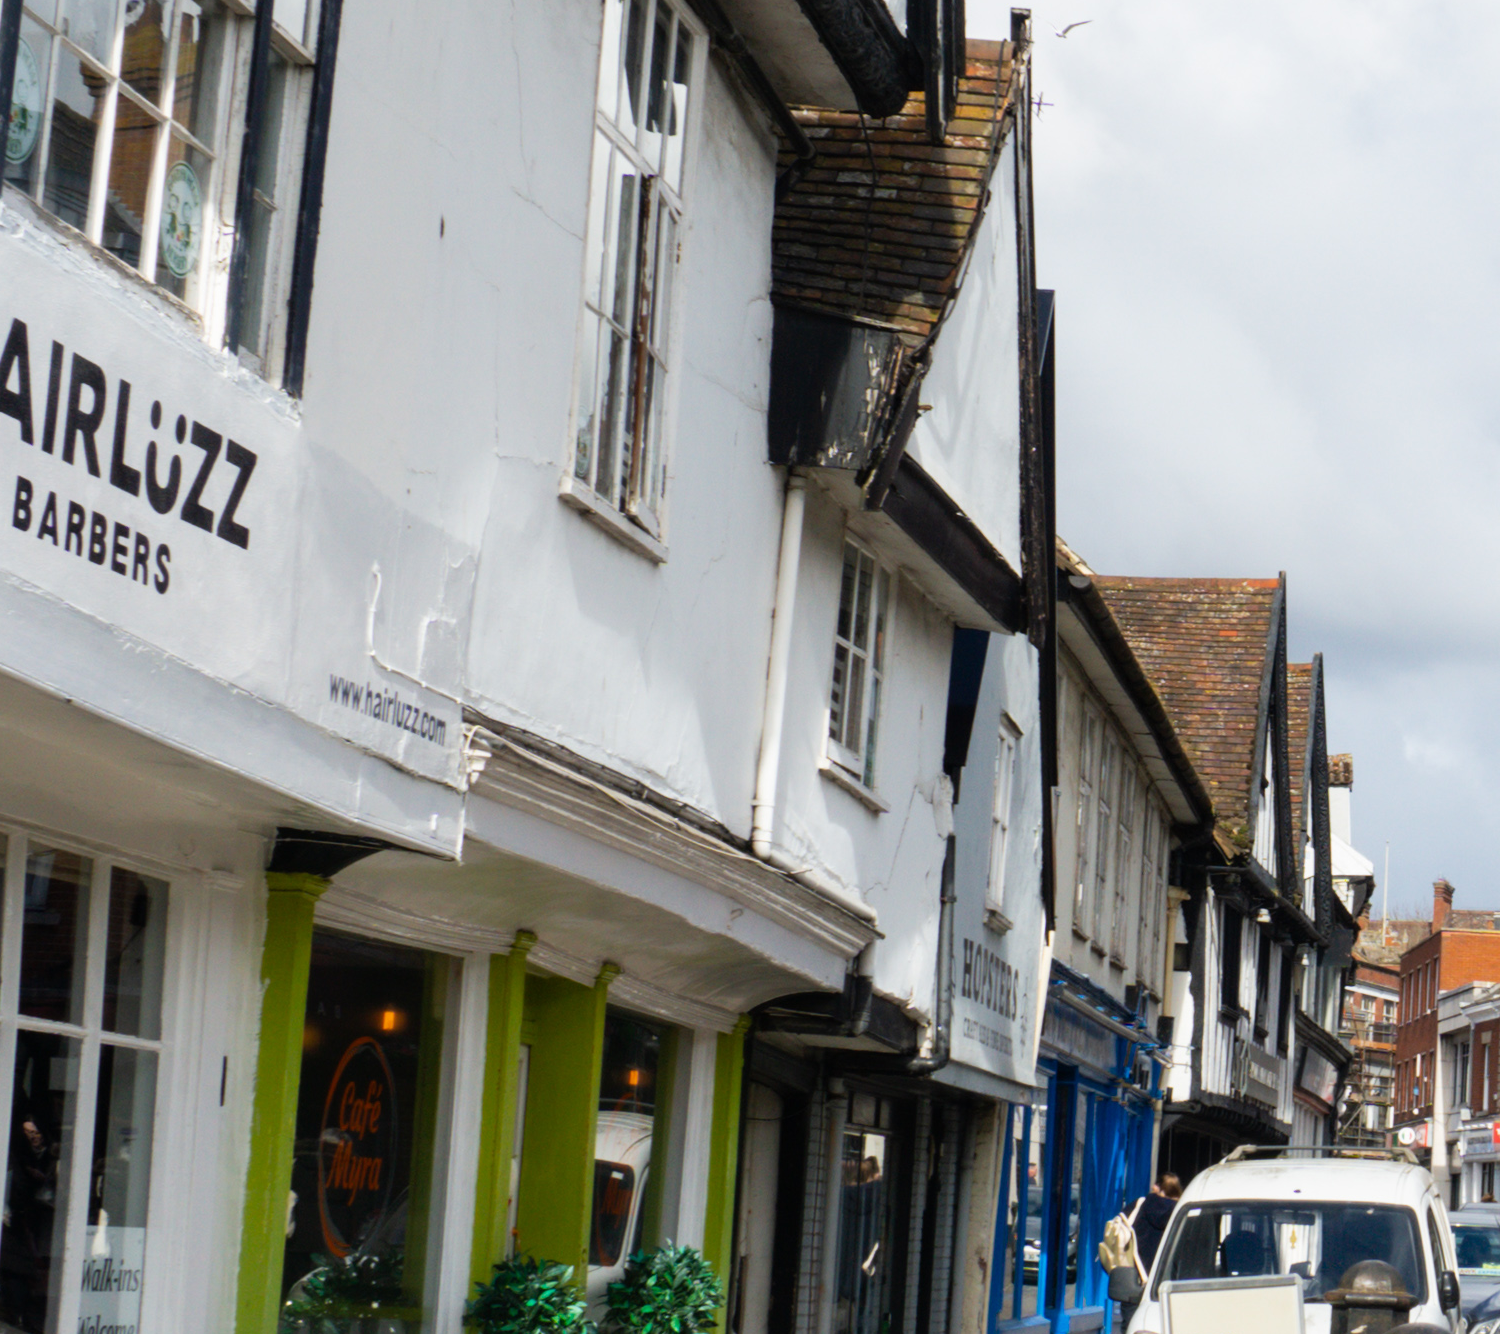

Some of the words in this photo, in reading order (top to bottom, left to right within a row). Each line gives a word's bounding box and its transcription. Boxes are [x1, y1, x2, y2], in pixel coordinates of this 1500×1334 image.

[12, 475, 171, 595] BARBERS
[329, 672, 446, 747] www.hairluzz.com
[962, 938, 1018, 1022] HOPSTERS
[339, 1079, 384, 1143] Café
[326, 1139, 383, 1208] Myra
[81, 1258, 141, 1293] Walk-ins
